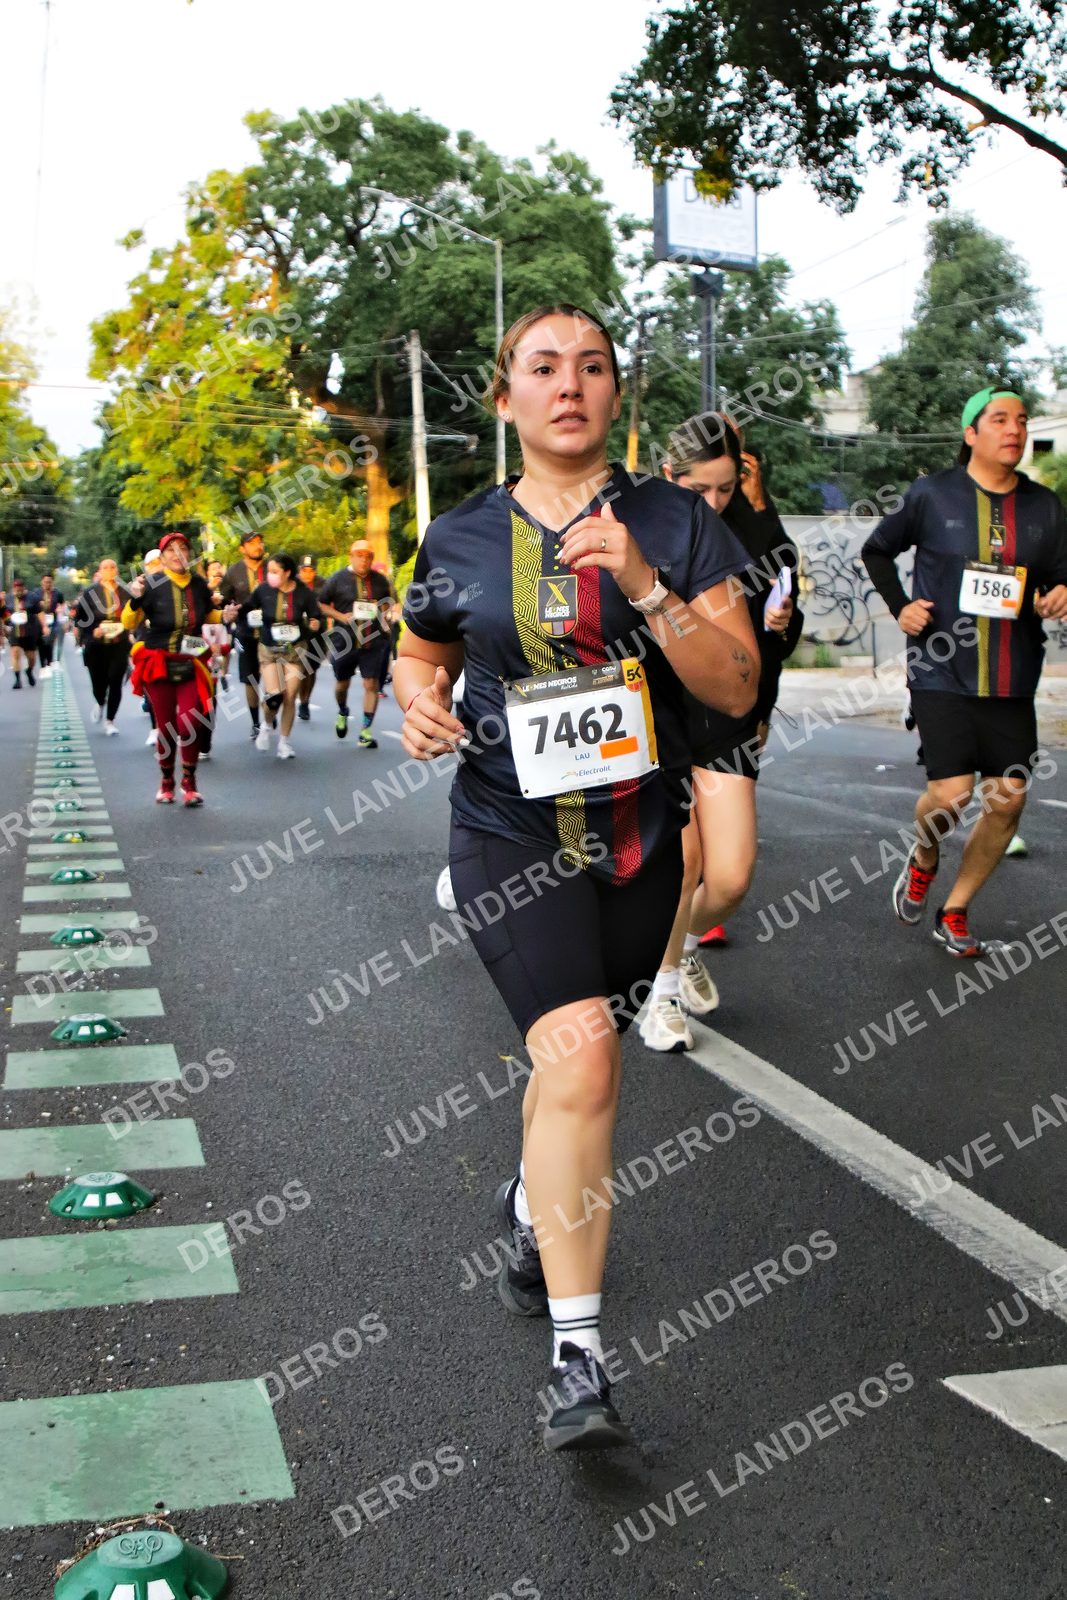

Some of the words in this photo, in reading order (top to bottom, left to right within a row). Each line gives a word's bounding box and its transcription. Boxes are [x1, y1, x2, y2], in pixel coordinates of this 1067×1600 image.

[972, 578, 1011, 598] 1586
[627, 666, 642, 681] 5K
[548, 676, 577, 688] NEGROS
[528, 703, 627, 755] 7462
[575, 753, 591, 761] LAU
[578, 765, 611, 777] Electrolit
